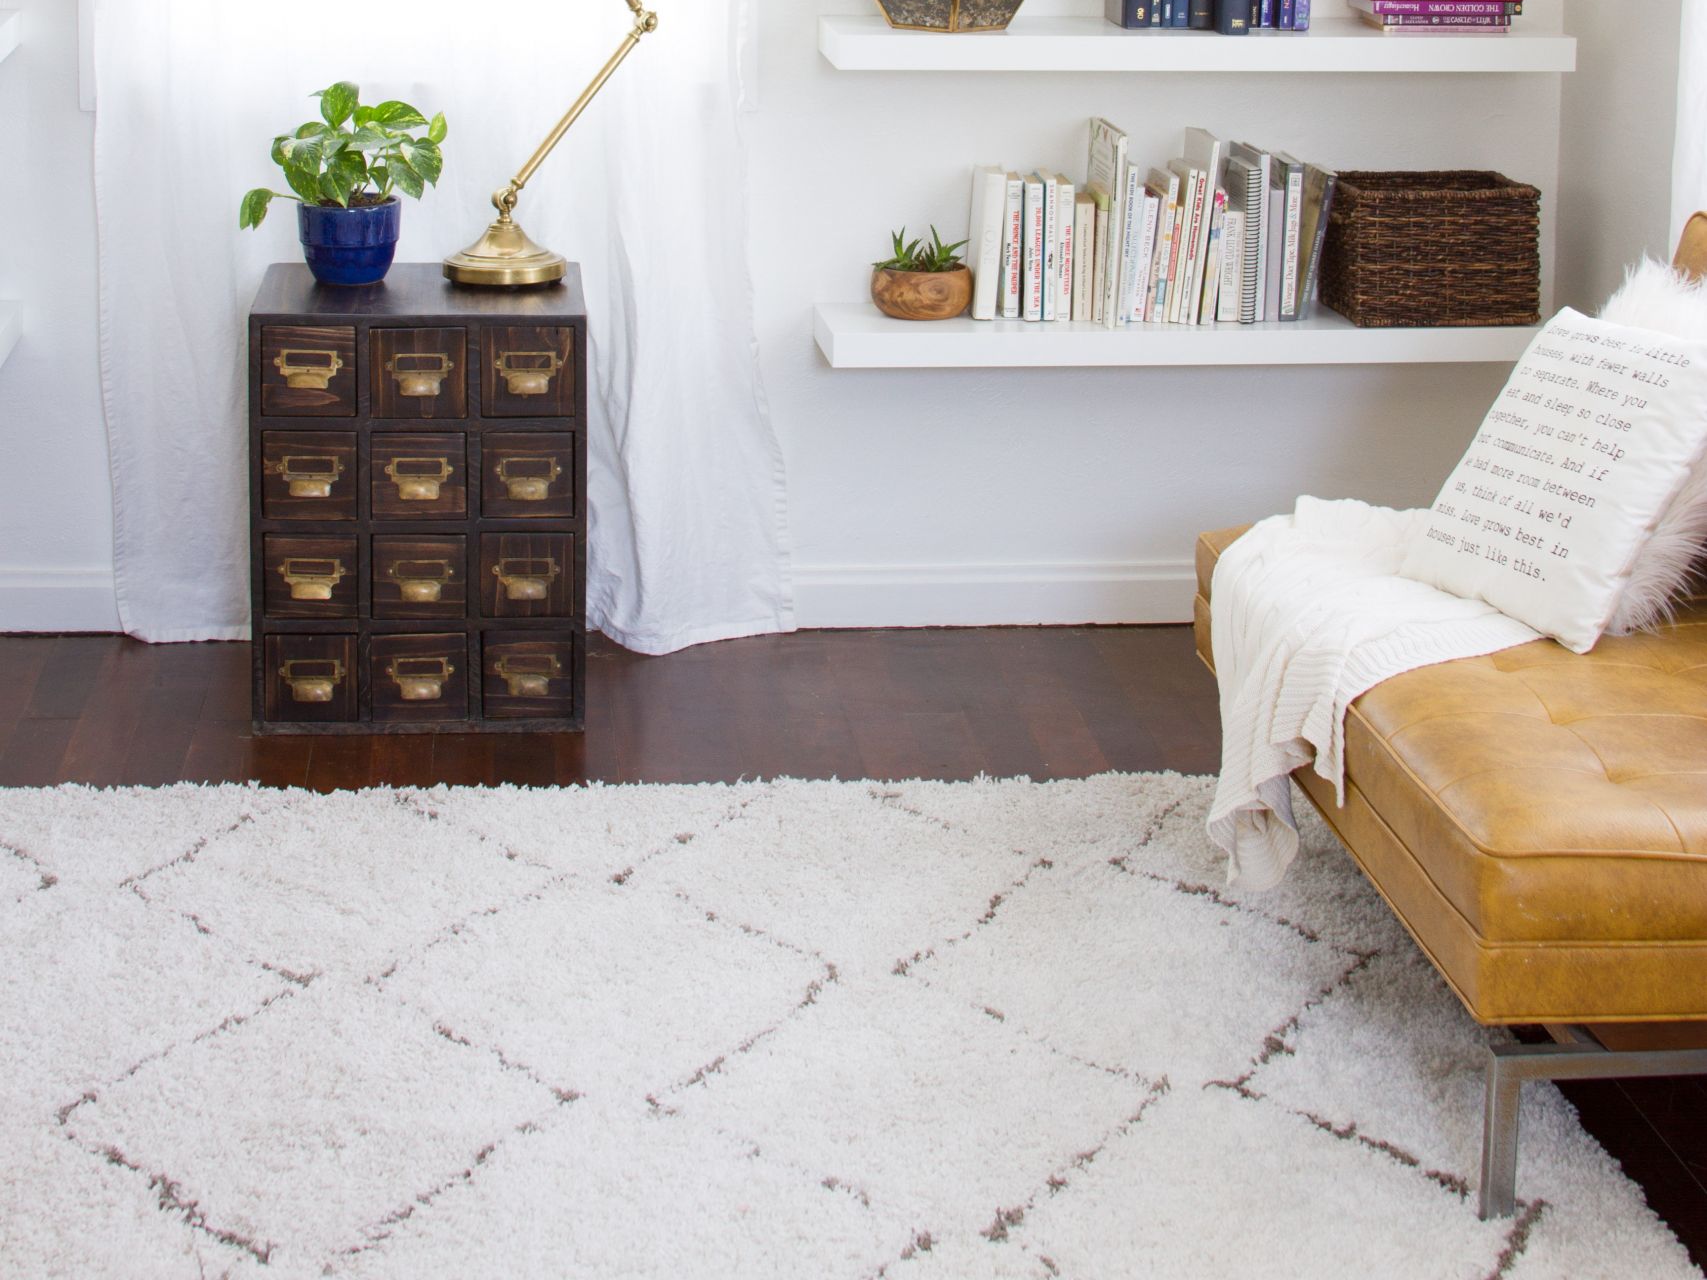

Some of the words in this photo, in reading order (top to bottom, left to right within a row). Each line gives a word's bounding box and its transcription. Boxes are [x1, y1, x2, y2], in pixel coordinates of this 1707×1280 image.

[1147, 203, 1155, 233] GLENN
[1228, 218, 1236, 238] FRANK
[1144, 236, 1152, 258] BECK
[1189, 226, 1198, 261] Homemade
[1227, 239, 1235, 260] LLOYD
[1224, 262, 1234, 287] WRIGHT
[1570, 351, 1594, 367] with
[1597, 358, 1628, 375] fewer
[1632, 369, 1669, 388] walls
[1645, 346, 1690, 368] little
[1533, 369, 1580, 389] separate.
[1586, 381, 1619, 400] Where
[1621, 395, 1648, 409] you
[1522, 391, 1542, 404] and
[1544, 398, 1574, 416] sleep
[1577, 408, 1591, 419] so
[1596, 413, 1632, 432] close
[1493, 437, 1555, 465] communicate.
[1560, 457, 1585, 473] And
[1588, 467, 1609, 482] if
[1533, 423, 1554, 435] you
[1557, 430, 1588, 446] can't
[1592, 439, 1625, 461] help
[1473, 457, 1489, 471] had
[1490, 463, 1515, 480] more
[1516, 473, 1540, 488] room
[1542, 478, 1596, 508] between
[1455, 480, 1467, 494] us,
[1472, 485, 1497, 502] think
[1499, 494, 1513, 506] of
[1514, 499, 1534, 515] all
[1538, 508, 1572, 529] we'd
[1461, 509, 1480, 525] Love
[1482, 519, 1511, 536] grows
[1515, 527, 1544, 549] best
[1550, 542, 1569, 558] in
[1427, 526, 1456, 546] houses
[1457, 536, 1480, 556] just
[1485, 545, 1507, 566] like
[1513, 559, 1546, 582] this.
